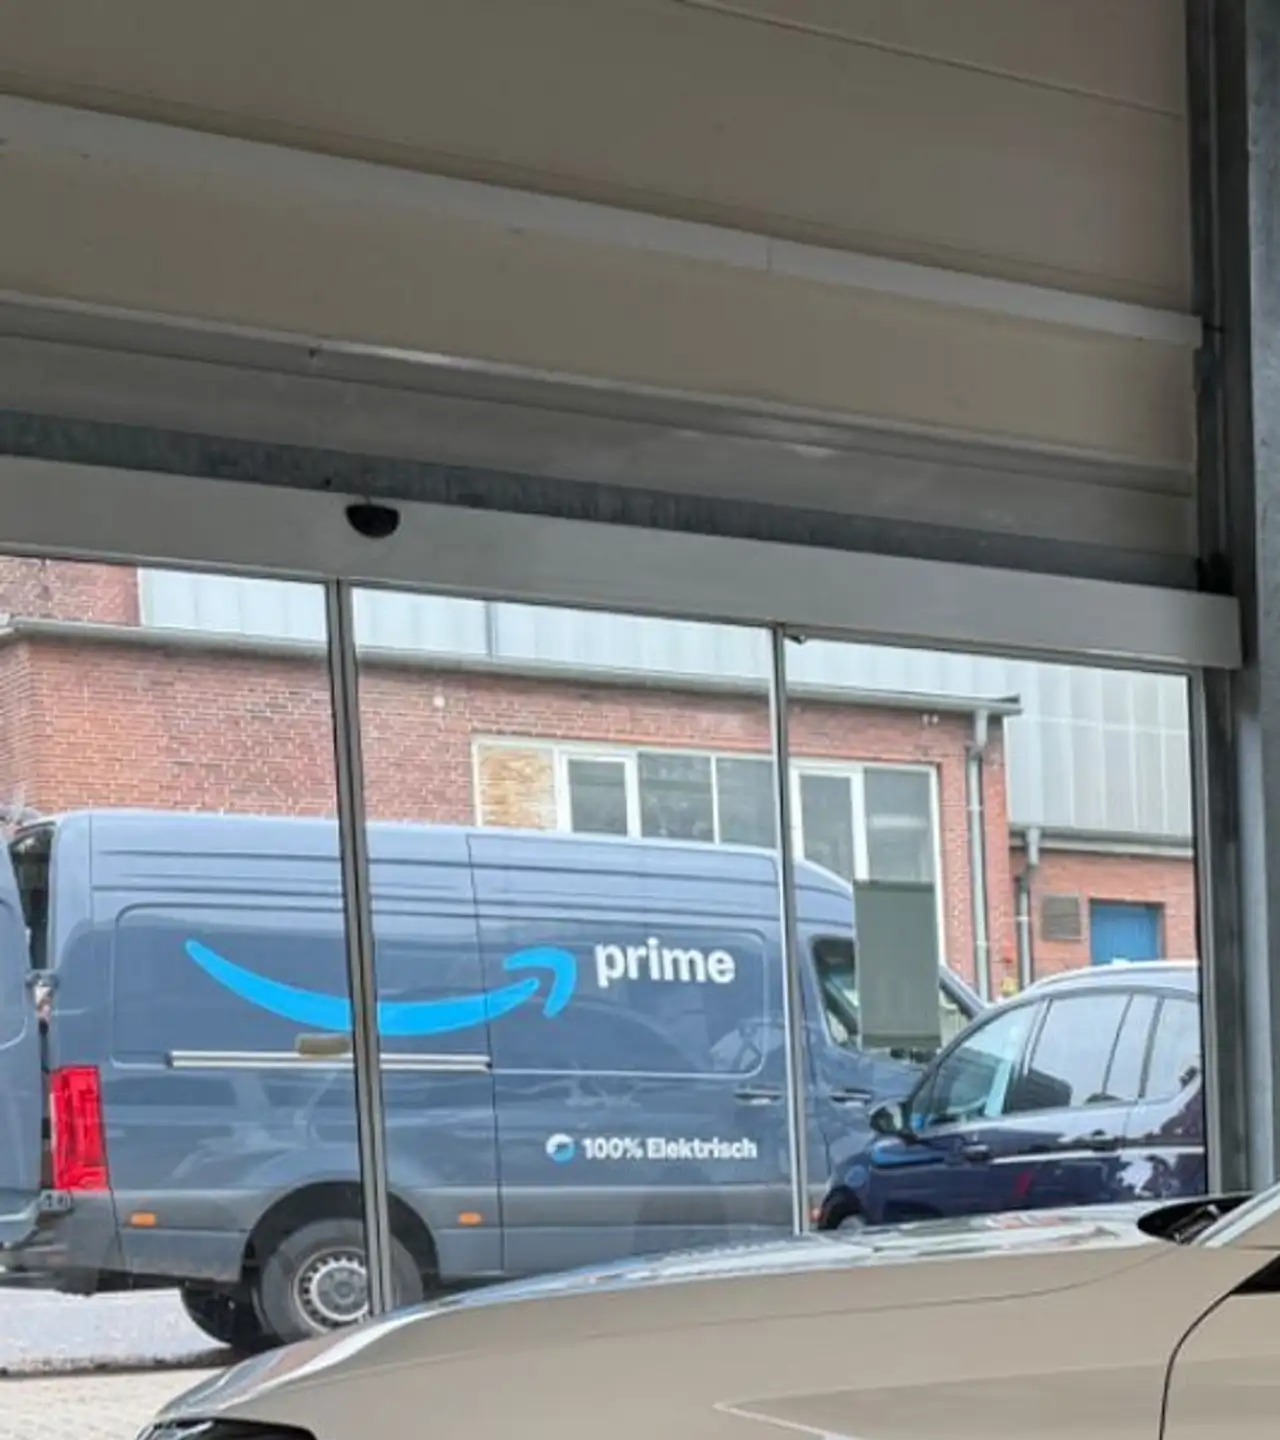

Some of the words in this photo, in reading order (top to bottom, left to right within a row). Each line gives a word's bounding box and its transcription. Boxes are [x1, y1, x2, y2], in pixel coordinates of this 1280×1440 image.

[595, 937, 735, 988] prime
[582, 1137, 643, 1160] 100%
[646, 1137, 758, 1160] Elektrisch
